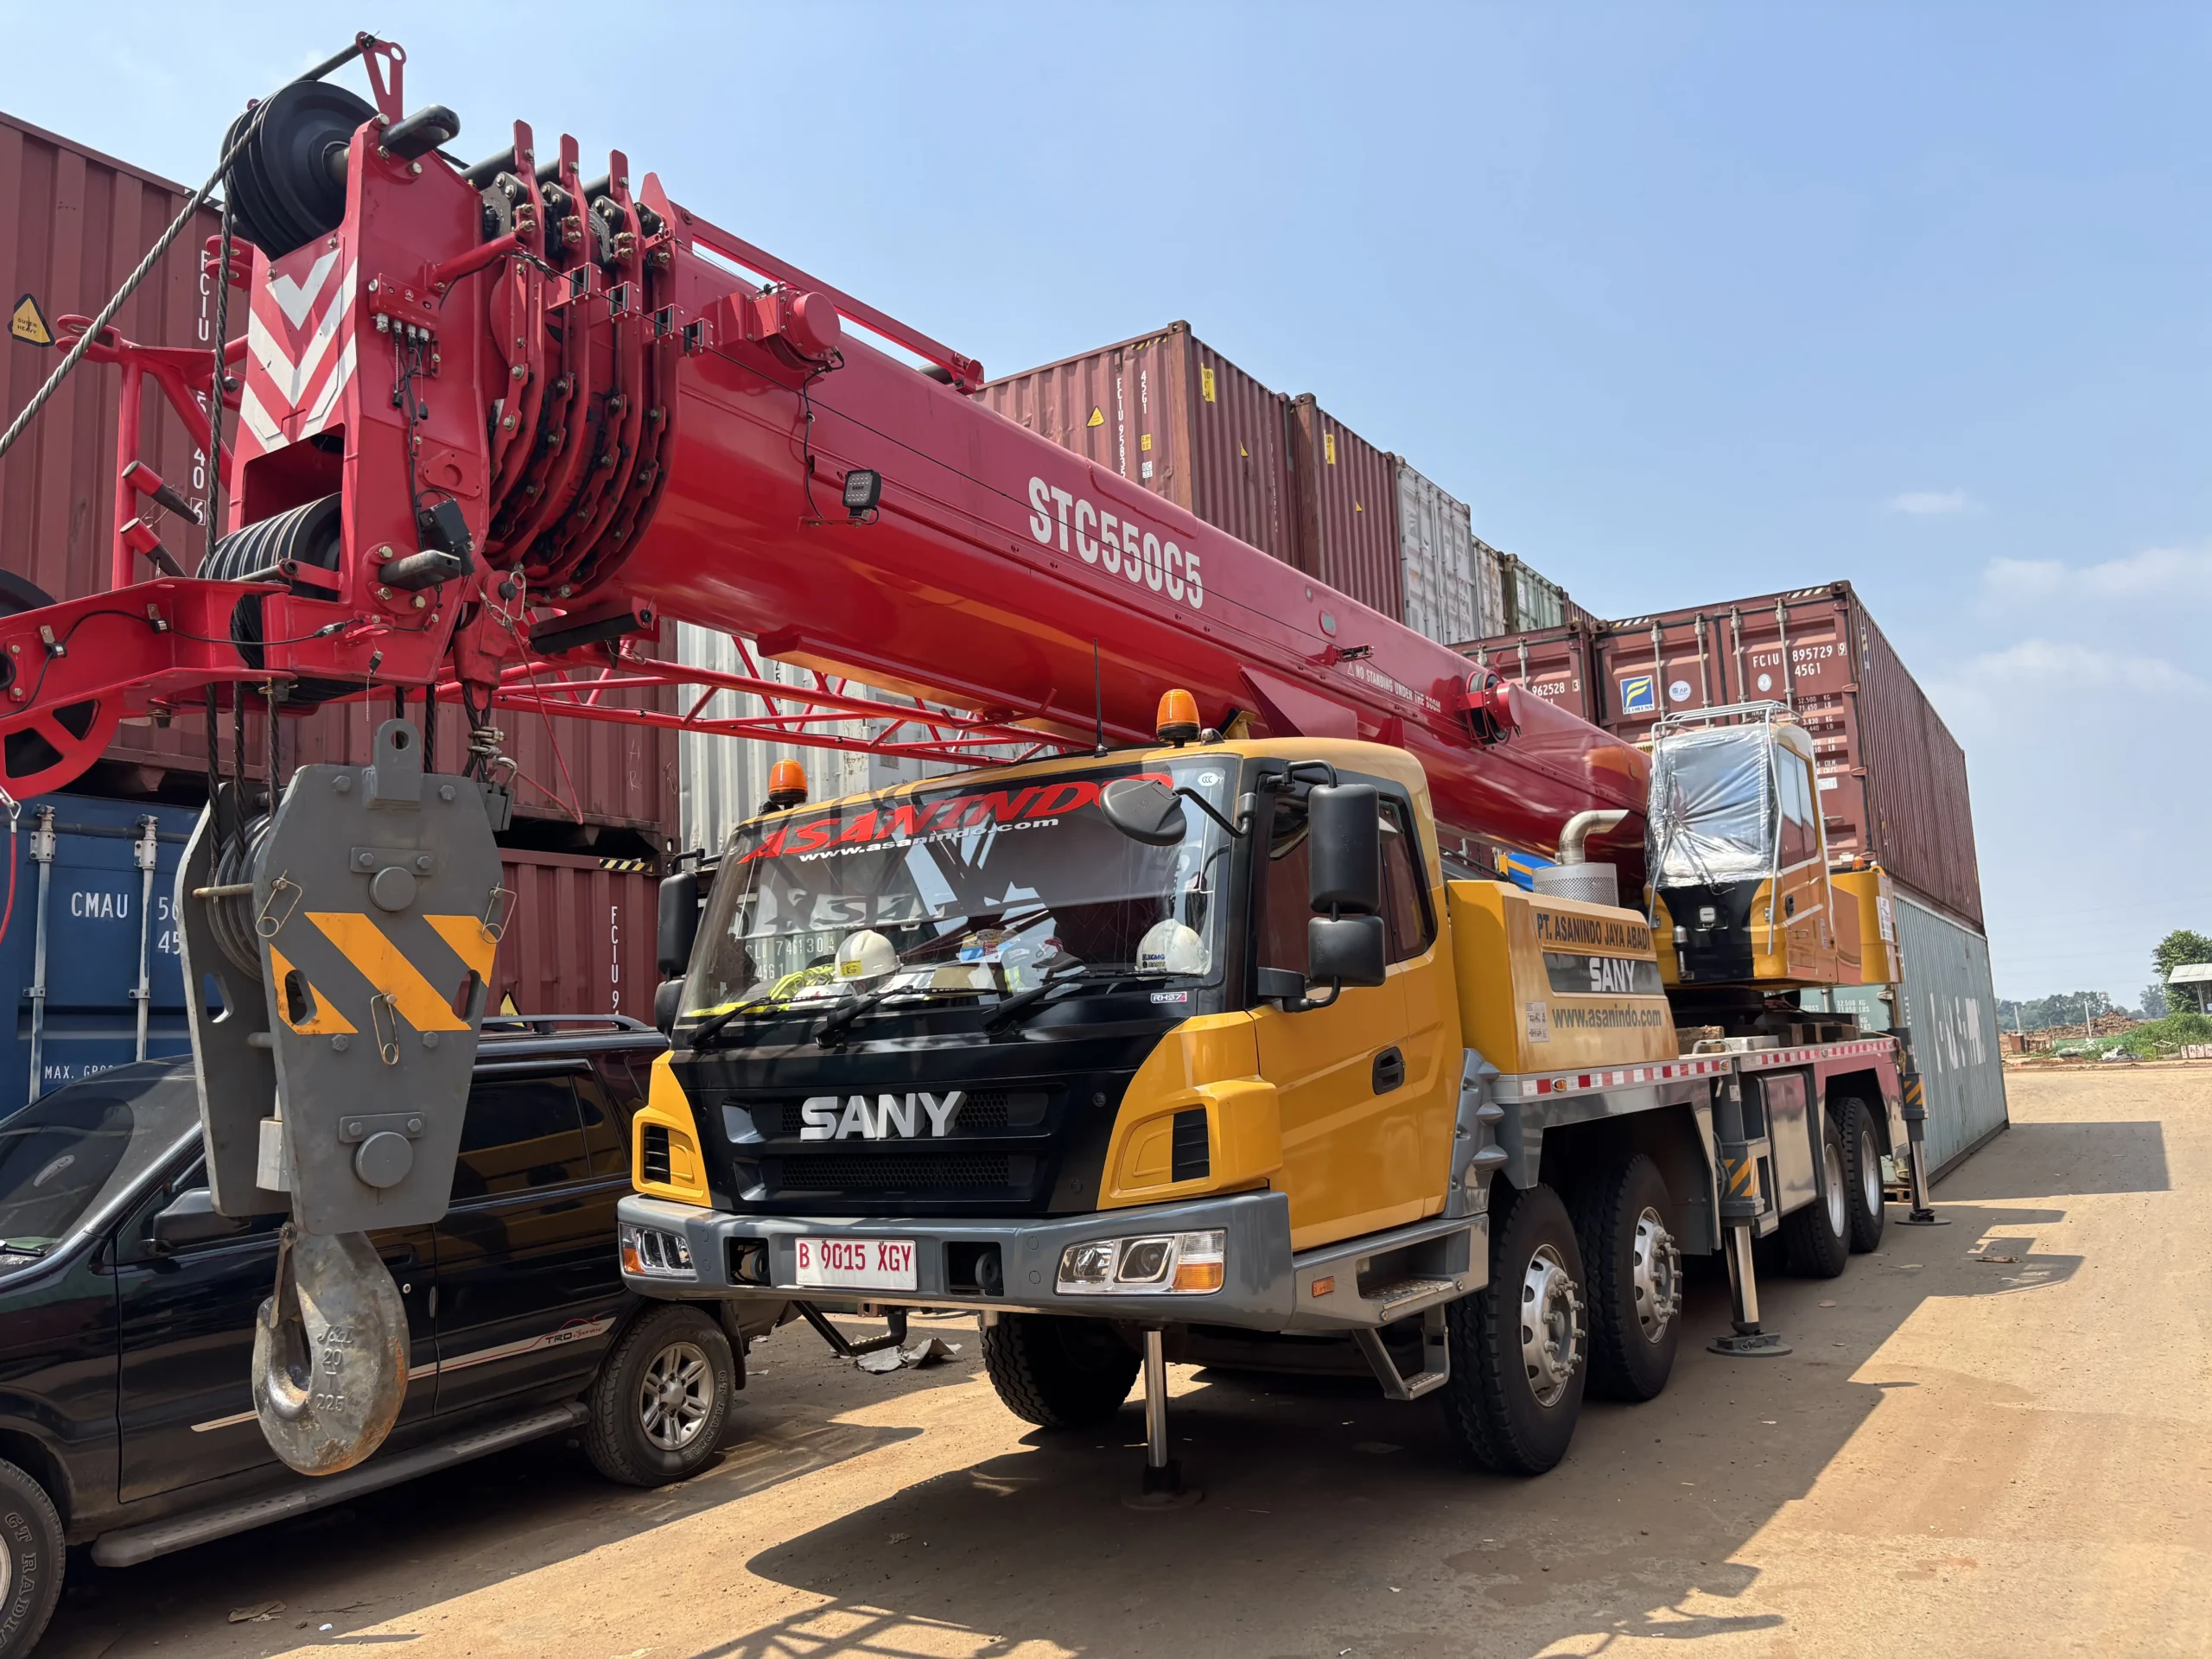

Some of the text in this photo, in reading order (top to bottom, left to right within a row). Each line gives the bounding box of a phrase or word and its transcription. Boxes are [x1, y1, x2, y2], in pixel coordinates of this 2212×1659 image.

[199, 250, 210, 341] FCIU
[17, 318, 37, 327] SUPER
[17, 325, 37, 334] HEAVY
[1028, 477, 1204, 609] STC550C5
[1753, 643, 1847, 668] FCIU 895729 9
[1795, 663, 1821, 677] 45G1
[1356, 664, 1440, 713] NO STANDING UNDER THE BOOM
[1532, 679, 1580, 696] 962528 3
[798, 818, 1058, 862] www.asanindo.com
[71, 892, 129, 918] CMAU
[1537, 913, 1650, 950] PT. ASANINDO JAYA ABADI
[1589, 957, 1636, 992] SANY
[1552, 1004, 1662, 1028] www.asanindo.com
[45, 1065, 74, 1079] MAX.
[800, 1090, 964, 1141] SANY
[799, 1243, 912, 1272] B 9015 XGY
[545, 1332, 573, 1344] TRD
[323, 1348, 343, 1365] 20
[316, 1393, 345, 1412] 225
[682, 1370, 728, 1461] GT RADIAL
[5, 1512, 33, 1542] GT
